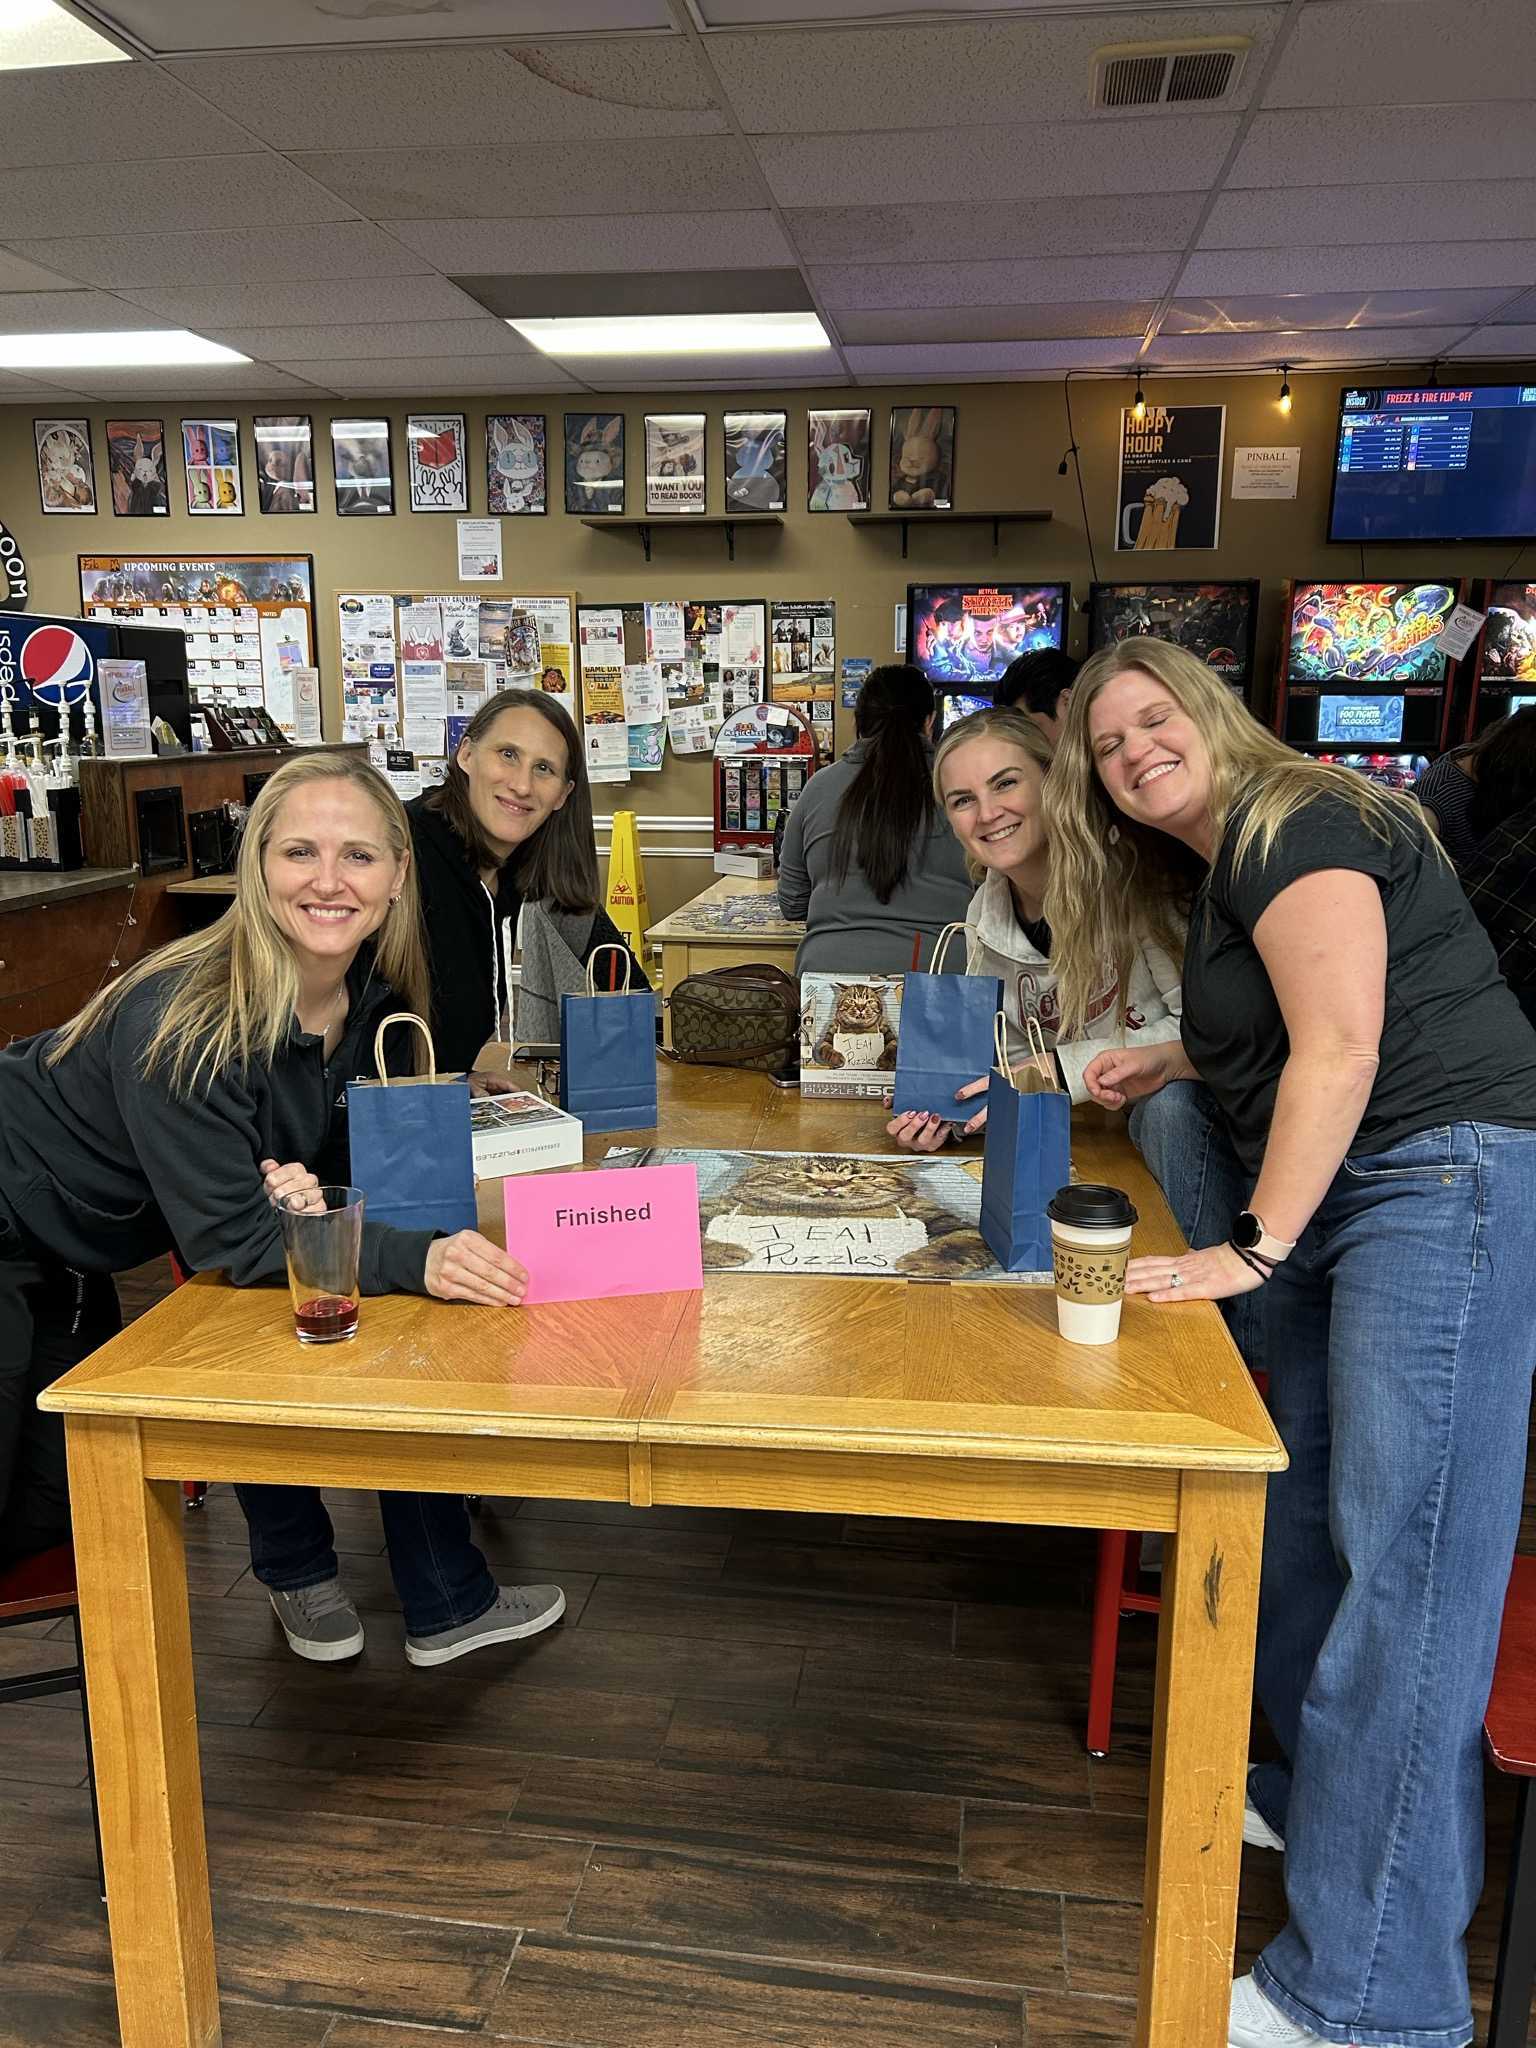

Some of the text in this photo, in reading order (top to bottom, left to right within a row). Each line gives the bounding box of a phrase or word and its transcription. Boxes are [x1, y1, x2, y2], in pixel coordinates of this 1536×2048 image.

[1386, 391, 1473, 404] FREEZE & FIRE FLIP-OFF
[1126, 416, 1175, 434] HOPPY
[1125, 436, 1163, 453] HOUR
[1247, 452, 1289, 461] PINBALL
[654, 482, 680, 491] WANT
[682, 480, 702, 491] YOU
[651, 492, 660, 500] TO
[124, 562, 176, 572] UPCOMING
[178, 562, 216, 572] EVENTS
[610, 896, 635, 905] CAUTION
[846, 1052, 876, 1067] Puzzles
[804, 1087, 855, 1095] PUZZLE
[556, 1202, 651, 1227] Finished
[757, 1242, 889, 1268] Puzzles
